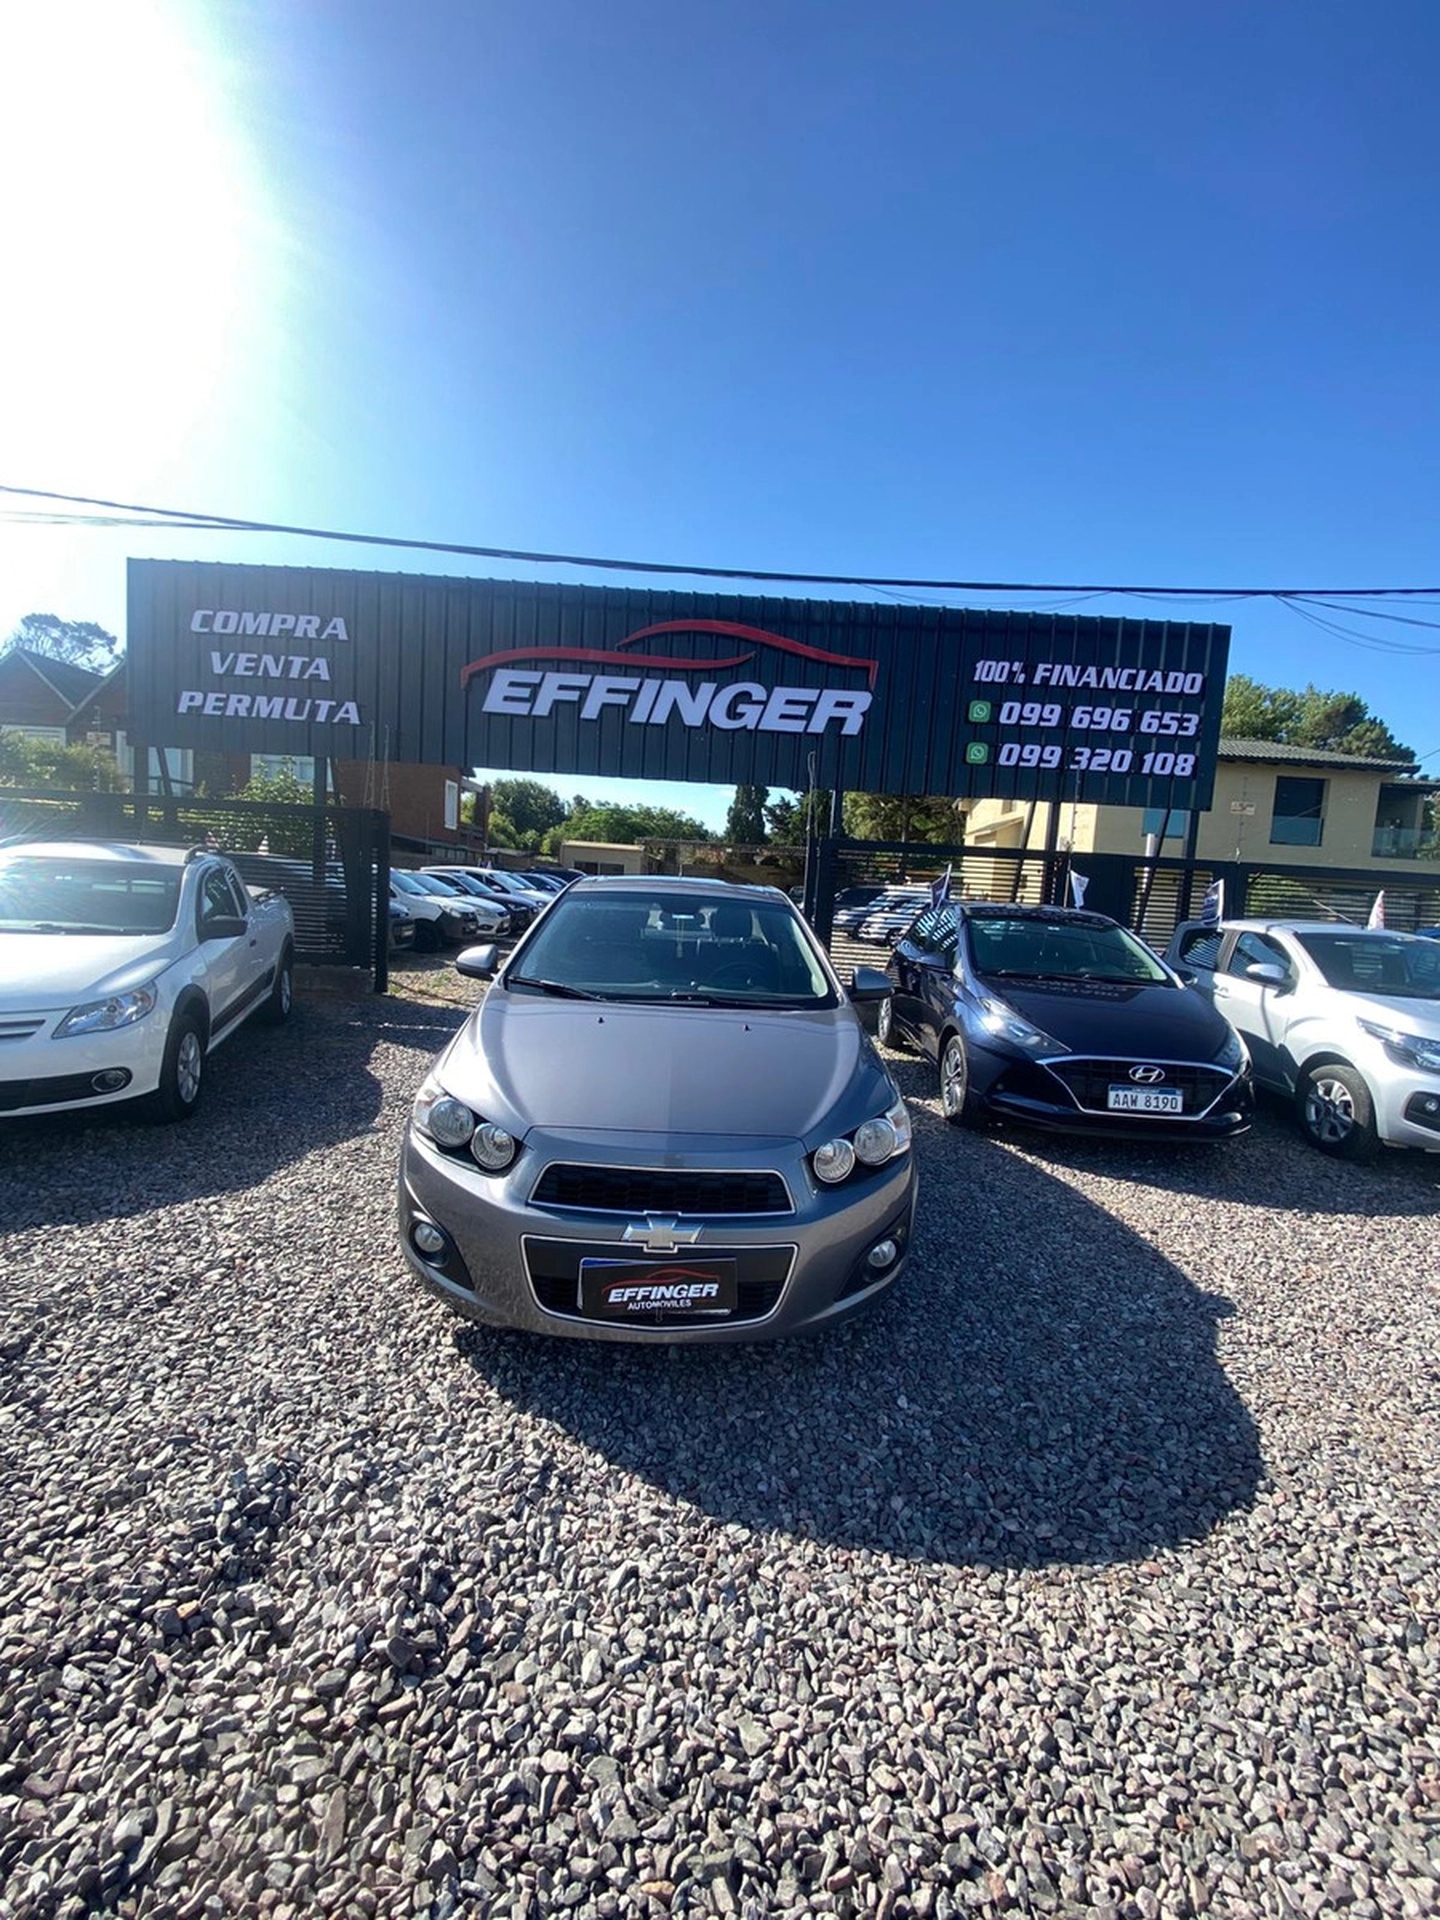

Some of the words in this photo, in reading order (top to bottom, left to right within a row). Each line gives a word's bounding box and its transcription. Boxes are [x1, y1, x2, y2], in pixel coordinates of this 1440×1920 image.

[190, 609, 349, 641] COMPRA
[210, 651, 331, 681] VENTA
[973, 659, 1026, 685] 100%
[1033, 663, 1204, 695] FINANCIADO
[177, 691, 360, 725] PERMUTA
[482, 668, 873, 736] EFFINGER
[998, 700, 1062, 728] 099
[1070, 706, 1130, 732] 696
[1139, 710, 1200, 737] 653
[997, 742, 1063, 769] 099
[1069, 747, 1132, 773] 320
[1141, 751, 1196, 776] 108
[1144, 1095, 1178, 1110] 8190
[608, 1283, 719, 1303] EFFINGER
[627, 1299, 692, 1311] AUTOMOVILES
